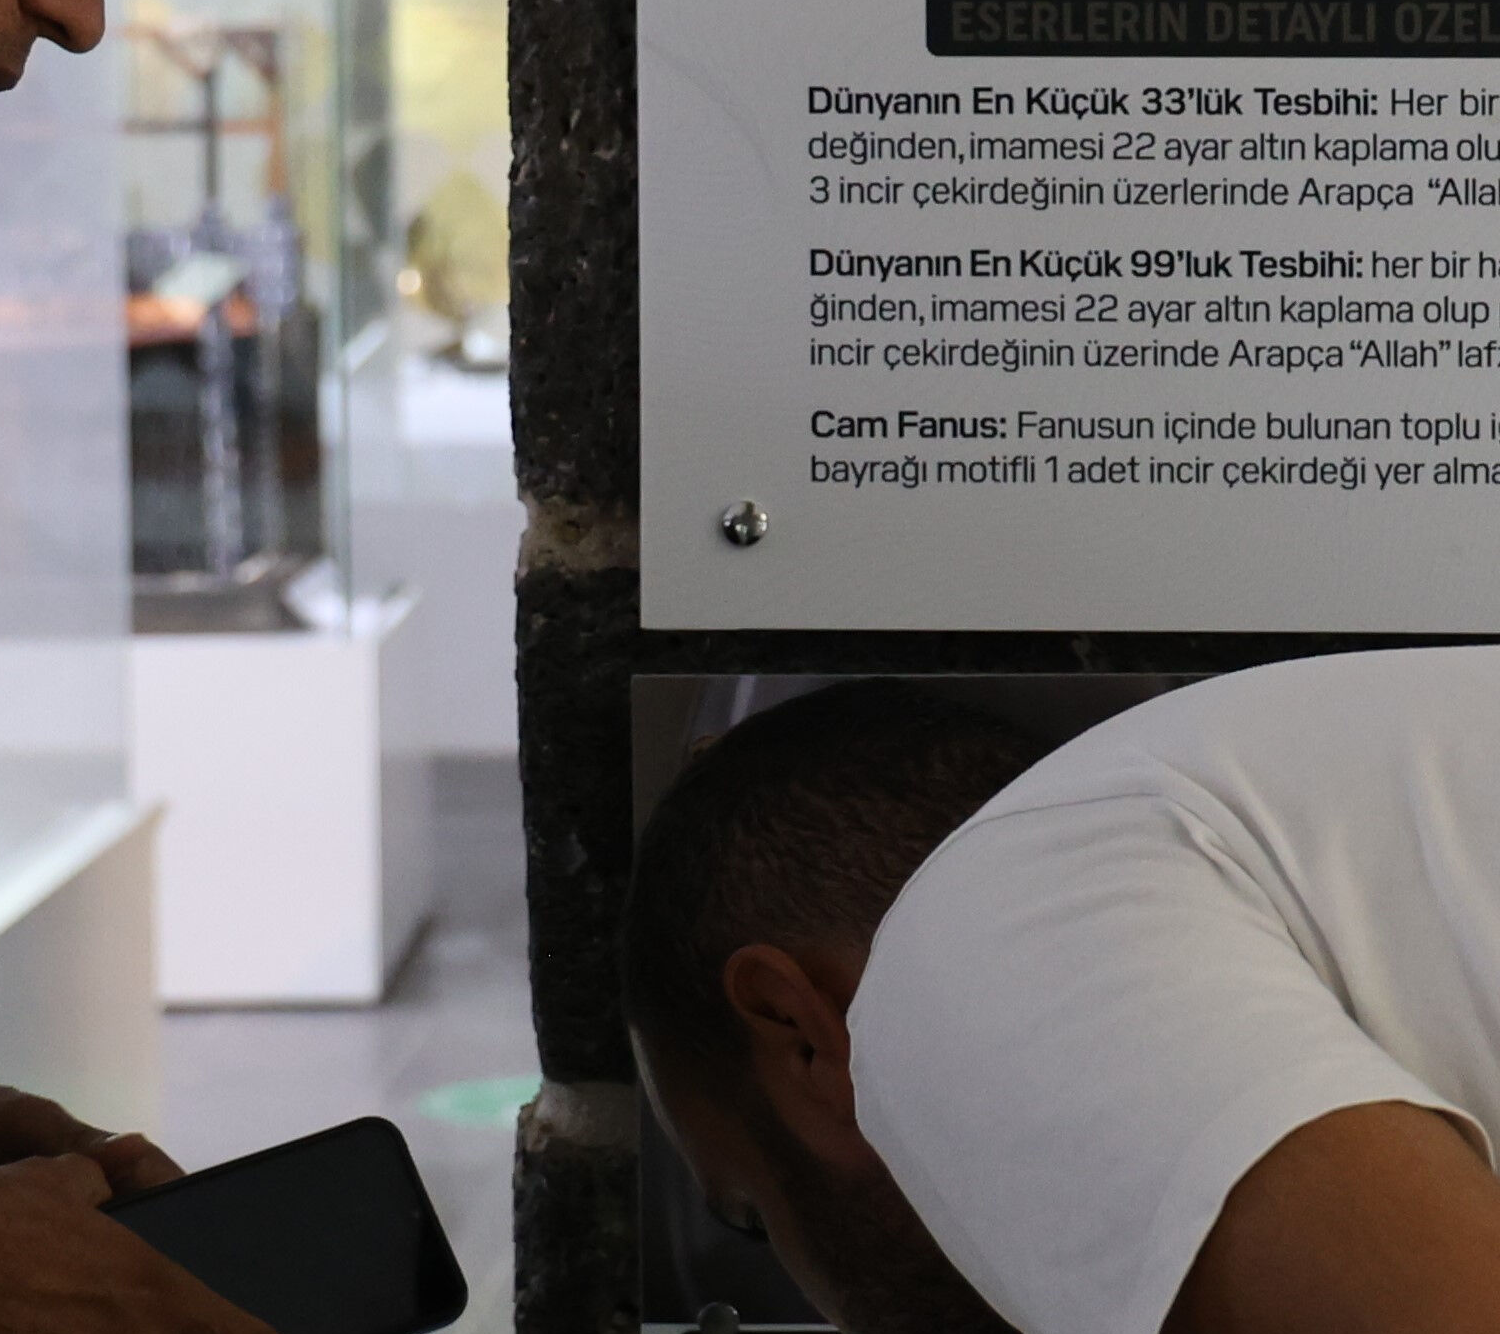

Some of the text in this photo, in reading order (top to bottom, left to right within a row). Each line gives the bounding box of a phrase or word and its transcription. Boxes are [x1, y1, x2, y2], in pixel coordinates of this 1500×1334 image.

[1205, 0, 1377, 44] DETAYLI
[807, 85, 962, 122] Dünyanın
[971, 86, 1015, 116] En
[1025, 86, 1131, 121] Küçük
[1252, 86, 1379, 117] Tesbihi:
[1390, 87, 1450, 117] Her
[1459, 87, 1500, 117] bir
[807, 130, 966, 166] değinden,
[969, 131, 1105, 161] imamesi
[1112, 131, 1157, 161] 22
[1163, 137, 1234, 168] ayar
[1238, 131, 1307, 162] altın
[1313, 131, 1449, 168] kaplama
[809, 174, 831, 205] 3
[839, 175, 905, 205] incir
[912, 175, 1105, 212] çekirdeğinin
[1112, 176, 1290, 207] üzerlerinde
[1297, 176, 1414, 213] Arapça
[809, 248, 963, 284] Dünyanın
[969, 248, 1012, 278] En
[1019, 248, 1124, 284] Küçük
[1238, 249, 1364, 280] Tesbihi:
[1371, 250, 1425, 280] her
[1430, 250, 1472, 280] bir
[810, 409, 889, 439] Cam
[897, 409, 1008, 440] Fanus:
[1017, 410, 1155, 441] Fanusun
[1163, 411, 1257, 445] içinde
[1266, 411, 1392, 441] bulunan
[1399, 411, 1482, 447] toplu
[810, 454, 928, 490] bayrağı
[936, 454, 1036, 484] motifli
[1044, 454, 1059, 484] 1
[1067, 454, 1141, 485] adet
[1149, 455, 1215, 485] incir
[1222, 455, 1367, 491] çekirdeği
[1374, 462, 1426, 491] yer
